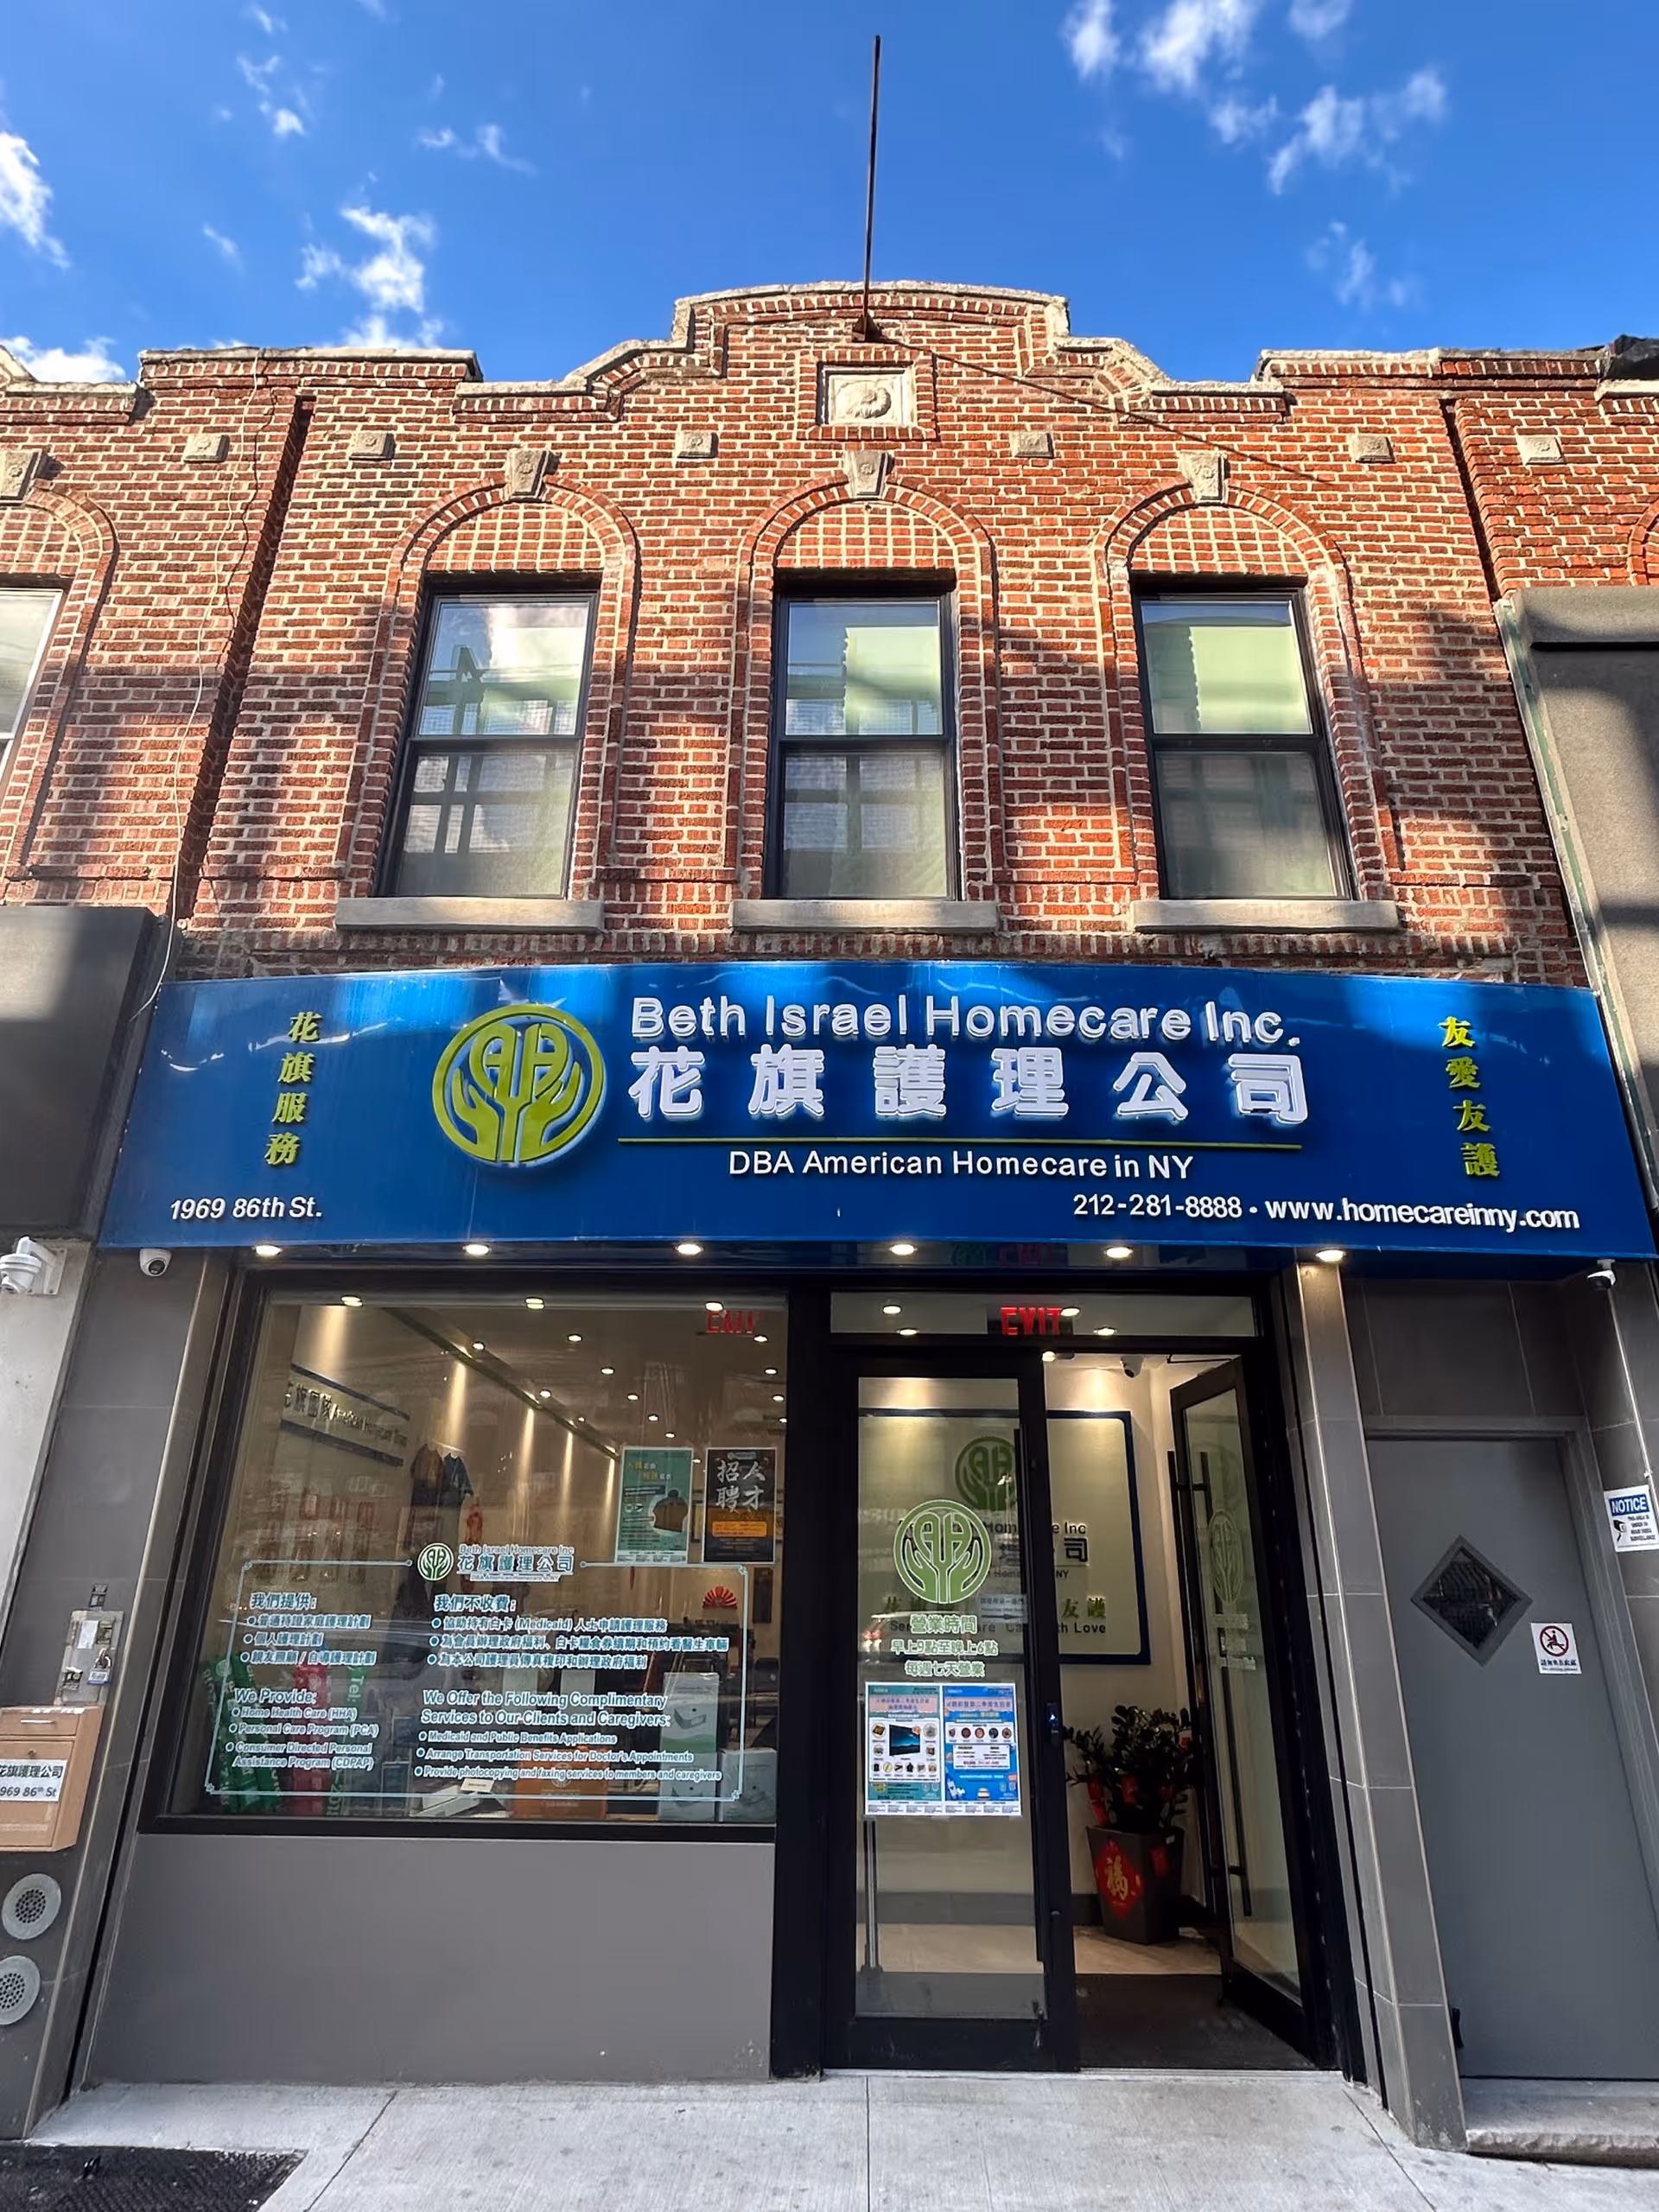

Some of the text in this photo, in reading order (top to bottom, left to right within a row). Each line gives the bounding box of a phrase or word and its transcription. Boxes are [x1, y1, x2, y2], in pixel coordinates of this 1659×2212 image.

[631, 995, 1301, 1047] Beth Israel Homecare Inc.
[264, 1011, 321, 1166] 花旗服務
[628, 1043, 1309, 1125] 花旗護理公司
[1438, 1016, 1501, 1178] 友愛友護
[729, 1150, 1194, 1179] DBA American Homecare in NY
[170, 1196, 322, 1219] 1969 86th St.
[1073, 1193, 1580, 1233] 212-281-8888 www.homecareinny.com
[1611, 1496, 1647, 1514] NOTICE
[1065, 1522, 1087, 1535] Inc
[459, 1544, 481, 1554] Beth
[482, 1544, 510, 1554] Israel
[511, 1544, 558, 1554] Homecare
[458, 1554, 574, 1572] 花旗護理公司
[515, 1618, 573, 1631] (Medicaid)
[911, 1614, 977, 1634] 營業時間
[1074, 1622, 1106, 1633] Love
[891, 1640, 999, 1656] 早上9點至晚上6點
[906, 1661, 985, 1677] 每週七天營業
[235, 1688, 317, 1704] We Provide:
[423, 1690, 667, 1710] We Offer the Following Complimentary
[241, 1707, 358, 1721] Home Health Care (HHA)
[421, 1709, 671, 1729] Services to Our Clients and Caregivers:
[238, 1723, 379, 1737] Personal Care Program (PCA)
[428, 1731, 617, 1745] Medicaid and Public Benefits Applications
[236, 1742, 372, 1754] Consumer Directed Personal
[425, 1748, 694, 1764] Arrange Transportation Services for Doctor's Appointments
[232, 1757, 374, 1770] Assistance Program (CDPAP)
[423, 1766, 721, 1783] Provide photocopying and faxing services to members and caregivers
[0, 1786, 21, 1796] 969
[46, 1786, 57, 1796] St
